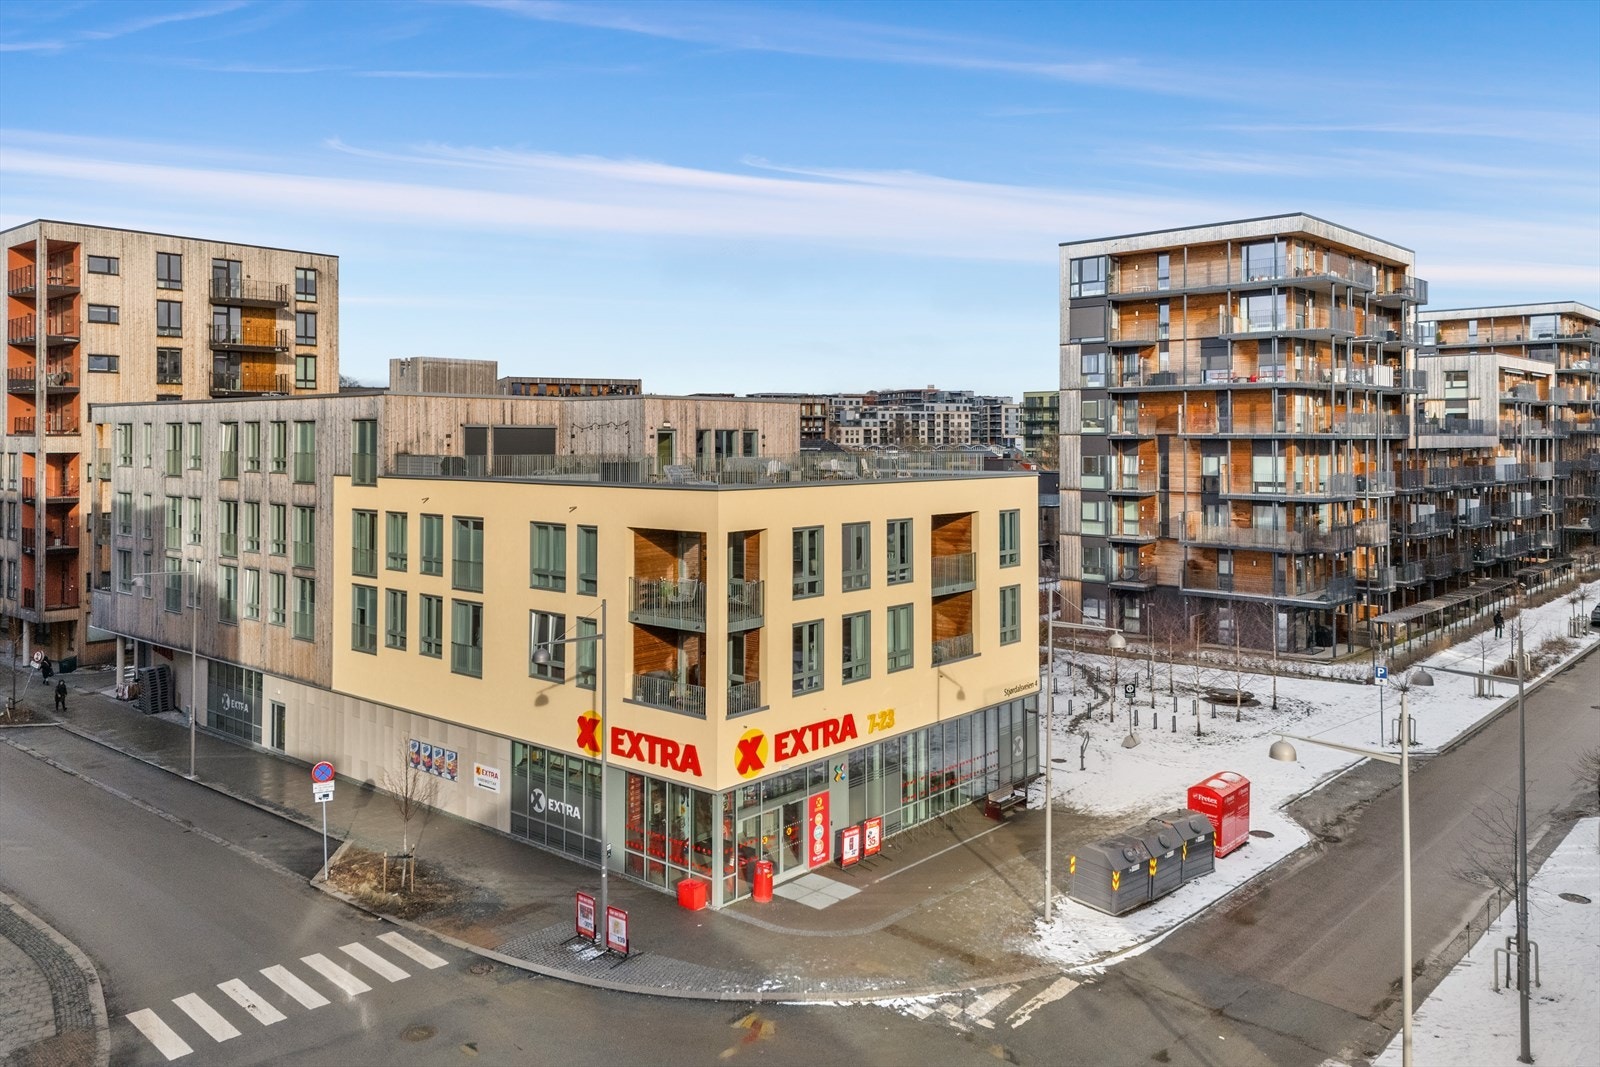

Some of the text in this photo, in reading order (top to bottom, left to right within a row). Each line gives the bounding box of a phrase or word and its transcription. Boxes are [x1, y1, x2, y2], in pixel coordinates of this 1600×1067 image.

[1377, 667, 1385, 677] P
[774, 713, 858, 763] EXTRA
[867, 708, 895, 735] 7-23
[611, 726, 703, 777] EXTRA
[481, 769, 499, 780] EXTRA
[1198, 794, 1218, 804] Fretex
[548, 798, 581, 820] EXTRA
